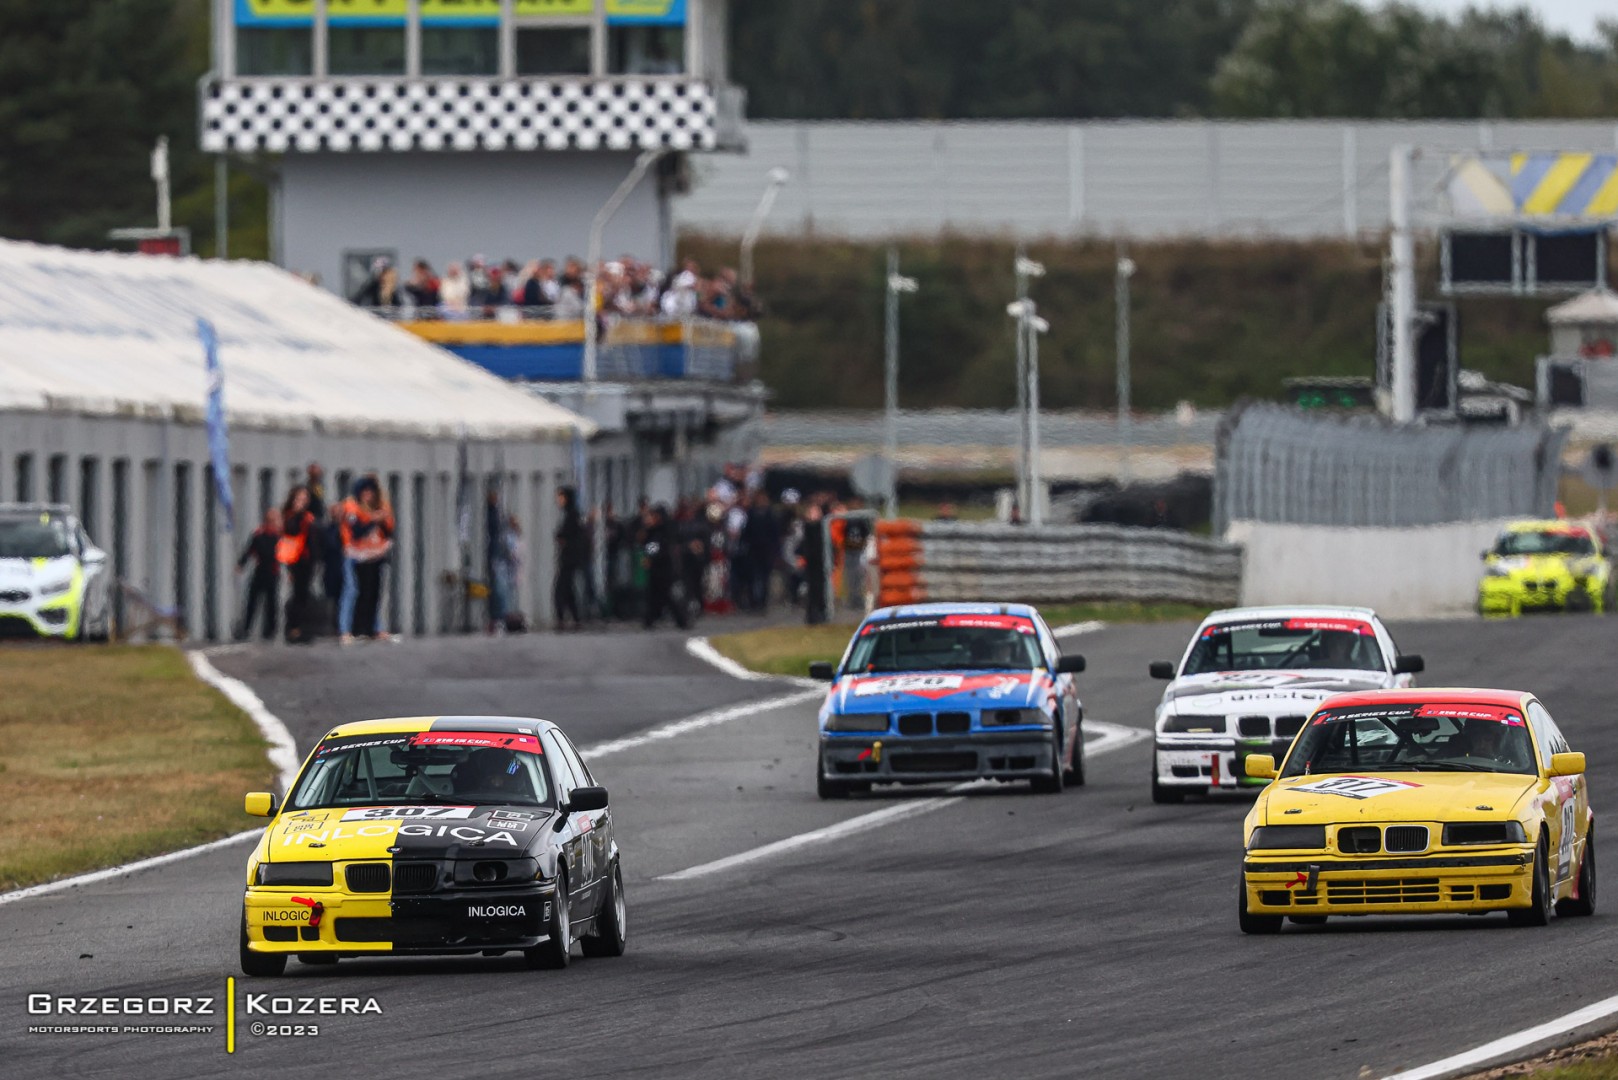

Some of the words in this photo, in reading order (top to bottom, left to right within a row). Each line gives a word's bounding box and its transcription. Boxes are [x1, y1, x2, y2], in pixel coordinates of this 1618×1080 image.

[1314, 779, 1399, 792] 317
[364, 807, 456, 818] 307
[282, 825, 518, 846] INLOGICA
[263, 910, 310, 921] INLOGIC
[468, 905, 527, 918] INLOGICA
